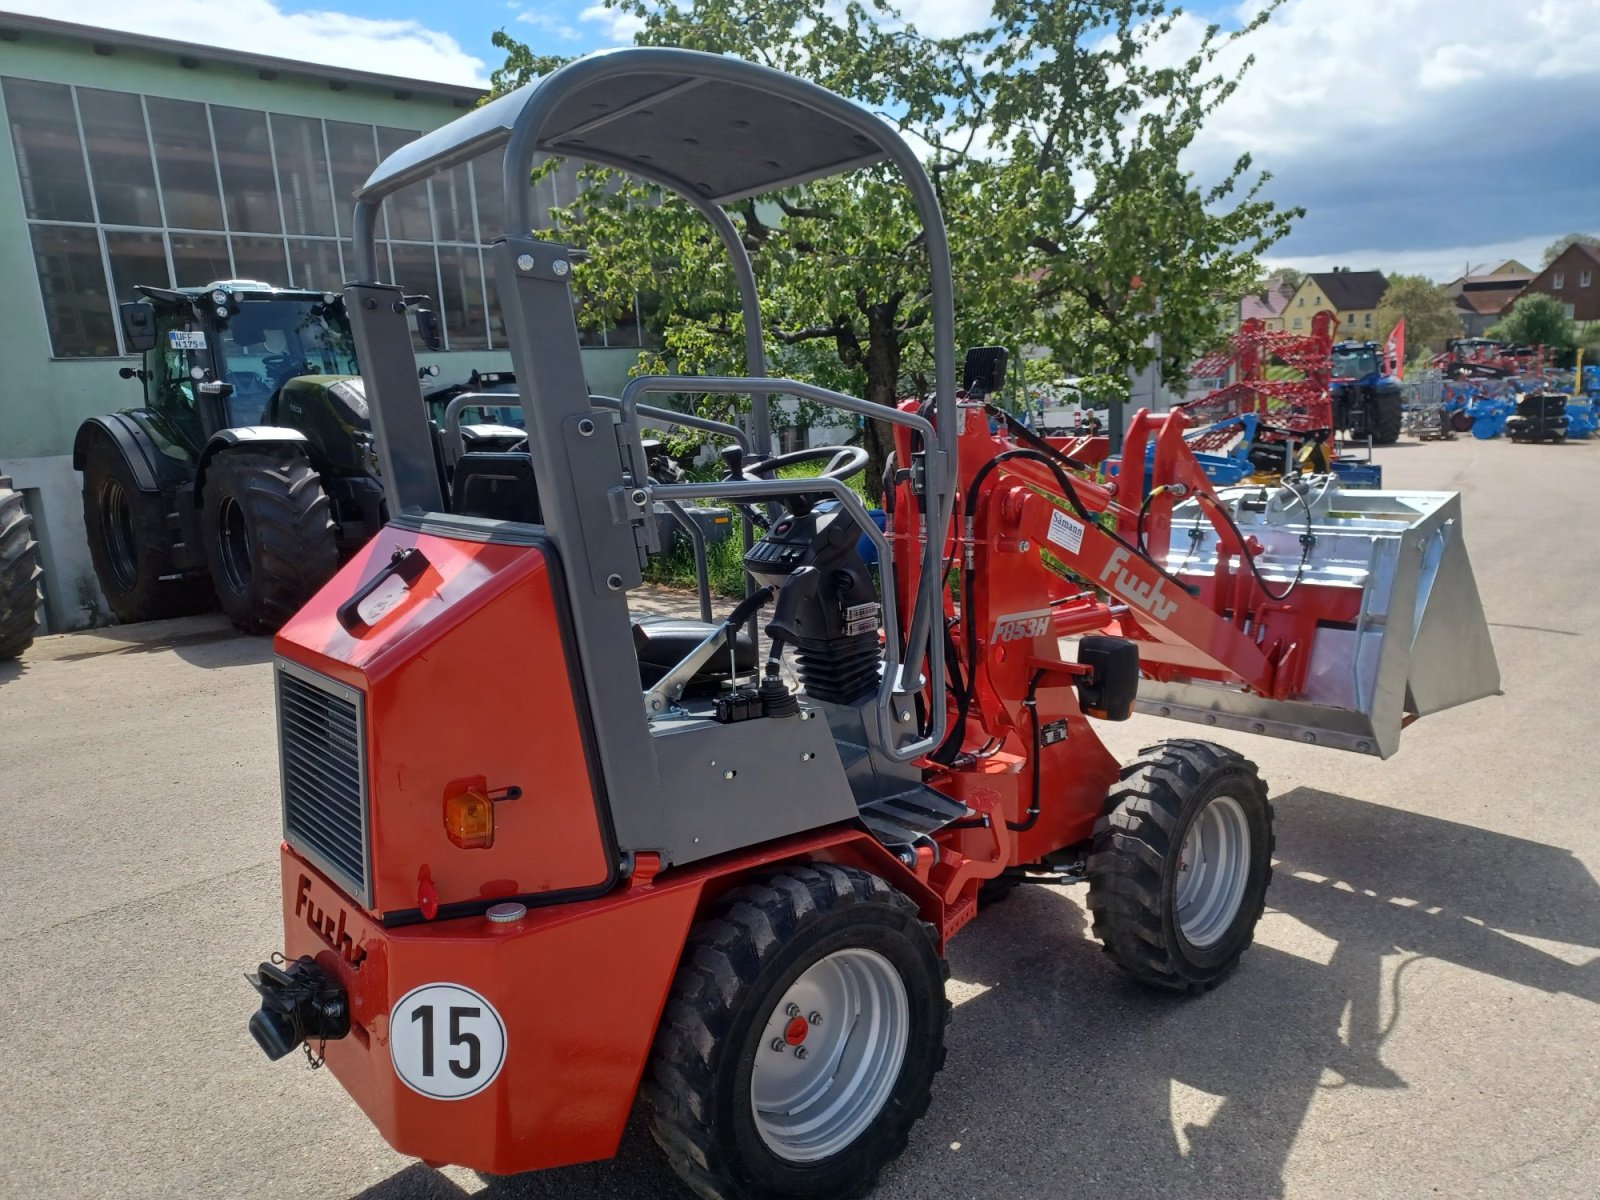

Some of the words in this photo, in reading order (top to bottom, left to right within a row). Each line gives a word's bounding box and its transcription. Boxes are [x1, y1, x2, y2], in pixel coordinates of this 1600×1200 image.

[176, 332, 192, 340] UFF
[1099, 546, 1178, 621] Fuchs
[991, 608, 1052, 645] F853H
[295, 873, 367, 969] Fuchs
[411, 1005, 481, 1079] 15
